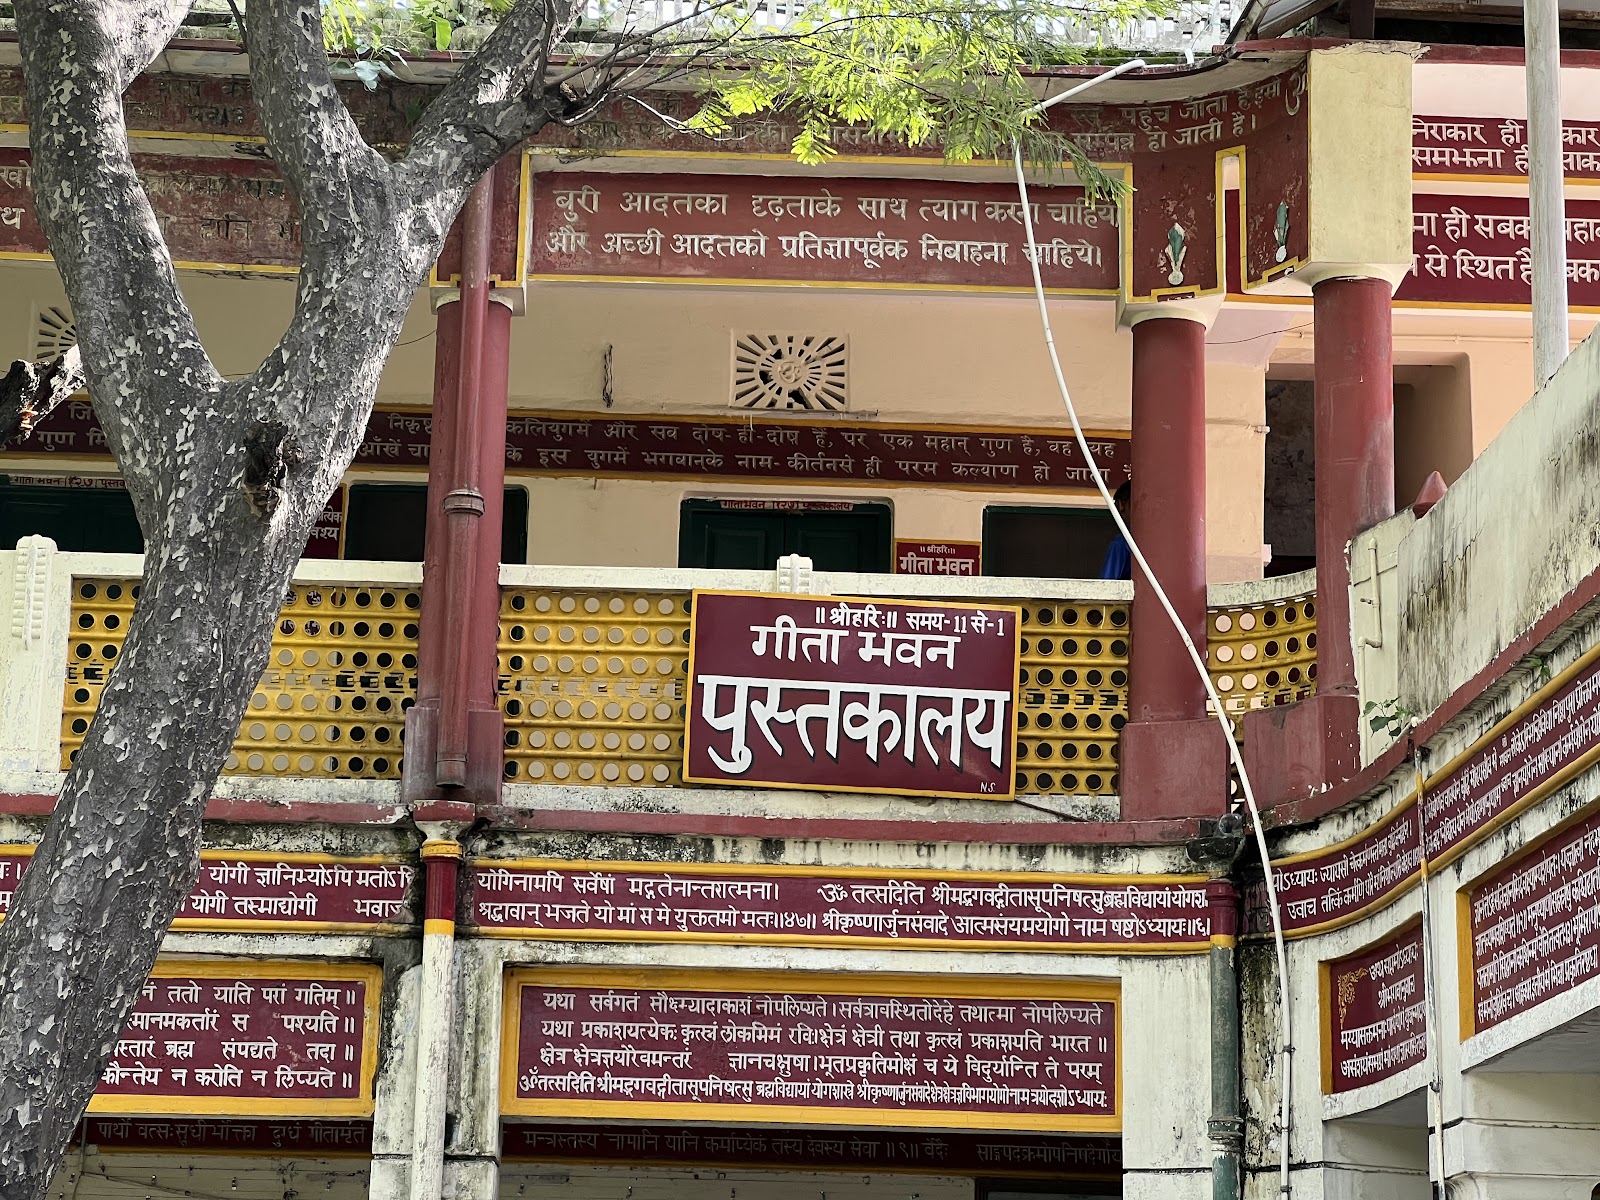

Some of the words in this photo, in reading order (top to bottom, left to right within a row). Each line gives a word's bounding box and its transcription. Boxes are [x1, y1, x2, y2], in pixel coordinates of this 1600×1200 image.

[1144, 126, 1168, 153] हो
[1173, 117, 1224, 146] जाती
[1498, 119, 1524, 147] ही
[553, 184, 601, 222] बुरी
[620, 191, 729, 218] आदतका
[857, 197, 908, 220] साथ
[919, 200, 979, 223] त्याग
[1442, 206, 1471, 243] ही
[546, 225, 590, 254] और
[601, 228, 665, 257] अच्छी
[669, 228, 769, 260] आदतको
[777, 229, 909, 269] प्रतिज्ञापूर्वक
[919, 233, 1008, 266] निबाहना
[1424, 245, 1449, 278] से
[1453, 248, 1518, 280] स्थित
[36, 430, 76, 452] गुण
[537, 447, 572, 468] इस
[584, 446, 630, 469] युगमें
[863, 456, 883, 477] ही
[895, 460, 939, 476] परम
[951, 462, 1019, 480] कल्याण
[1033, 461, 1050, 482] हो
[603, 420, 638, 440] और
[841, 431, 870, 449] पर
[879, 432, 914, 450] एक
[979, 437, 1013, 457] गुण
[1047, 439, 1073, 457] वह
[900, 551, 934, 574] गीता
[936, 556, 974, 576] भवन
[750, 615, 849, 665] गीता
[857, 631, 961, 670] भवन
[698, 675, 1011, 774] पुस्तकालय
[208, 861, 251, 885] योगी
[477, 868, 565, 893] योगिनामपि
[571, 871, 616, 895] सर्वेषां
[850, 879, 925, 906] तत्सदिति
[190, 889, 229, 914] योगी
[232, 891, 318, 916] तस्माद्योगी
[478, 901, 544, 927] श्रद्धावान्
[545, 900, 591, 923] भजते
[594, 900, 616, 924] यो
[617, 902, 638, 924] मां
[639, 907, 653, 925] स
[655, 902, 672, 926] मे
[674, 905, 740, 932] युक्ततमो
[821, 907, 949, 937] श्रीकृष्णार्जुनसंवादे
[951, 912, 1071, 937] आत्मसंयमयोगो
[1072, 918, 1107, 937] नाम
[1287, 898, 1317, 920] उवाच
[167, 980, 202, 1005] ततो
[213, 981, 254, 1005] याति
[261, 983, 287, 1005] परां
[294, 982, 341, 1010] गतिम्
[543, 992, 576, 1011] यथा
[589, 990, 641, 1013] सर्वगतं
[649, 991, 752, 1016] सौक्ष्म्यादाकाशं
[755, 995, 828, 1018] नोपलिप्यते
[959, 1005, 1016, 1023] तथात्मा
[1022, 1002, 1103, 1026] नोपलिप्यते
[231, 1013, 250, 1033] स
[281, 1013, 339, 1035] पश्यति
[541, 1020, 574, 1038] यथा
[580, 1017, 678, 1041] प्रकाशयत्येकः
[720, 1019, 782, 1043] लोकमिमं
[852, 1023, 885, 1047] क्षेत्री
[889, 1030, 920, 1049] तथा
[968, 1029, 1044, 1053] प्रकाशयति
[1049, 1035, 1092, 1053] भारत
[164, 1040, 195, 1059] ब्रह्म
[220, 1036, 278, 1060] संपद्यते
[306, 1042, 336, 1064] तदा
[171, 1069, 188, 1087] न
[194, 1065, 244, 1088] करोति
[251, 1070, 267, 1088] न
[274, 1065, 336, 1089] लिप्यते
[728, 1053, 811, 1077] ज्ञानचक्षुषा
[923, 1058, 938, 1075] च
[943, 1054, 959, 1076] ये
[965, 1053, 1039, 1082] विदुर्यान्ति
[1044, 1056, 1059, 1079] ते
[1065, 1061, 1103, 1085] परम्
[664, 1130, 700, 1152] यानि
[772, 1139, 804, 1154] तस्य
[848, 1136, 880, 1159] सेवा
